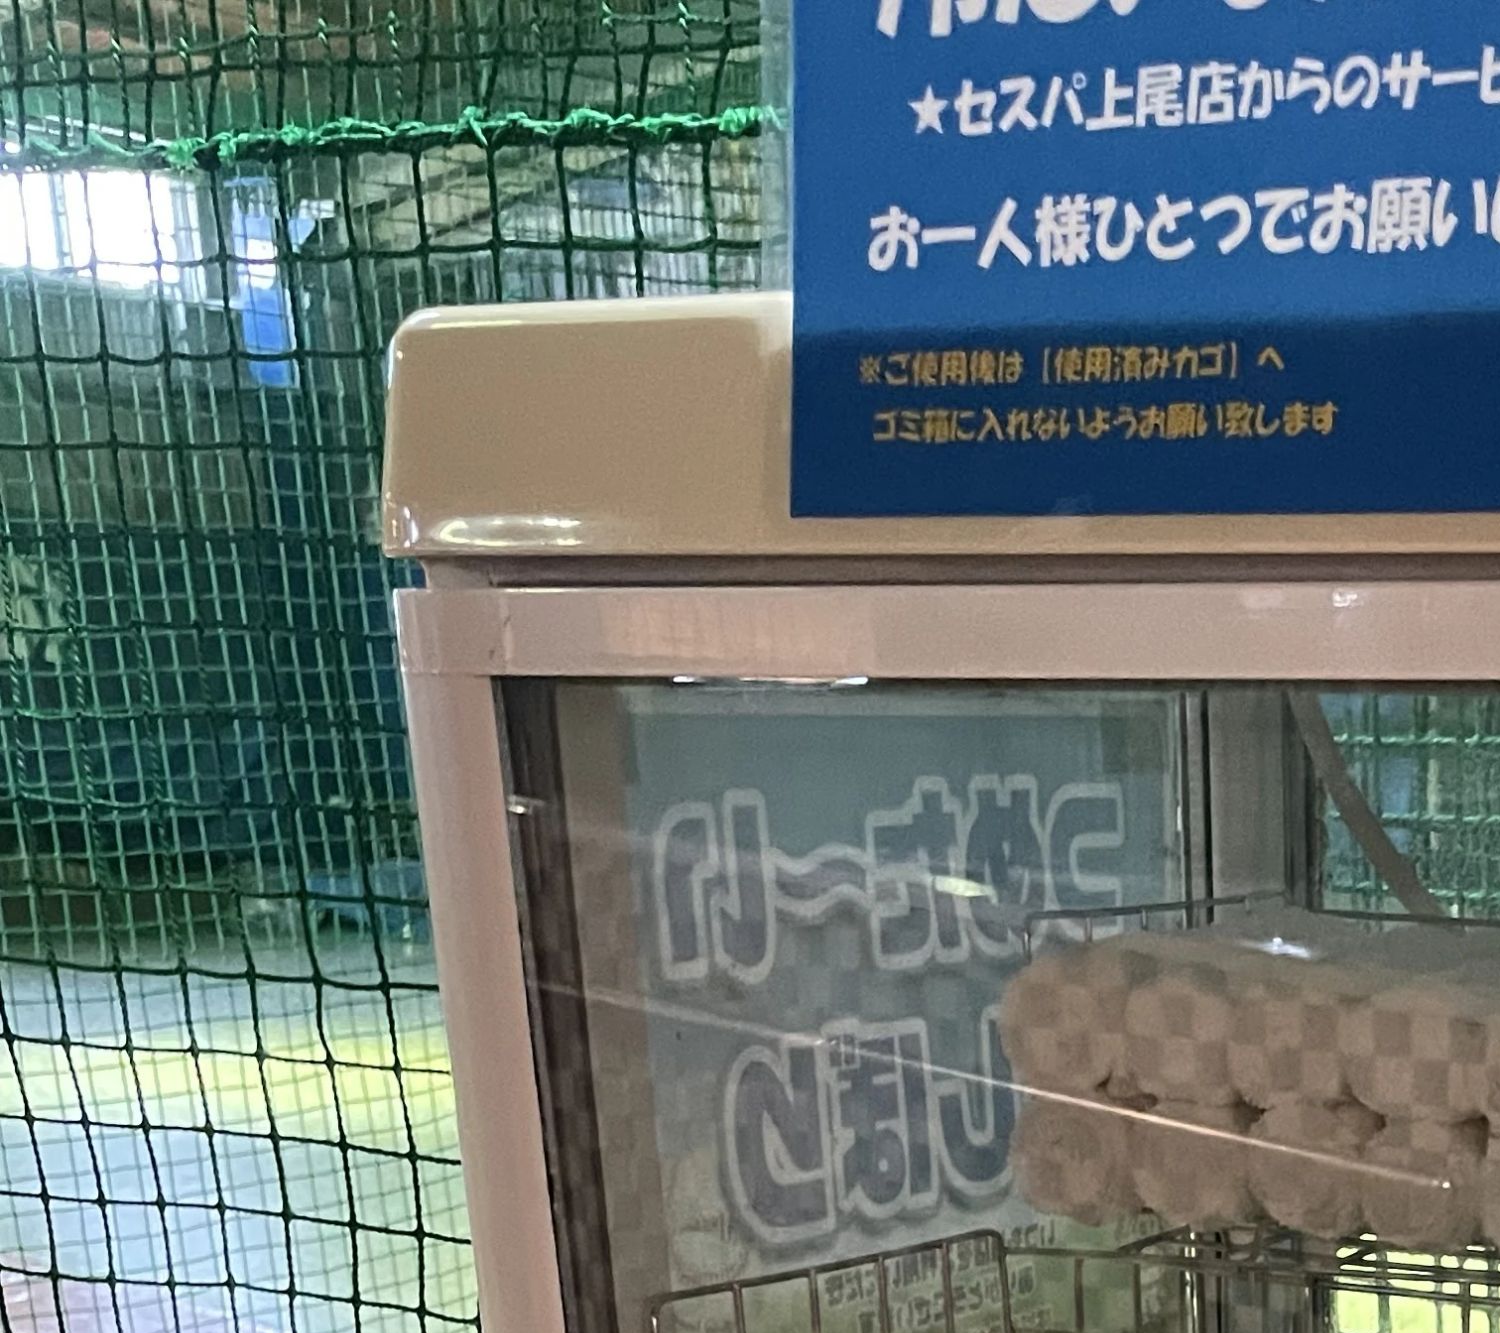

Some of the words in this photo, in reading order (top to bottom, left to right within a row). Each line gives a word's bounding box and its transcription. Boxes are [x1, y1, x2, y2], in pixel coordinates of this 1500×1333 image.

[872, 401, 1337, 443] ゴミ箱に入れないようお願い致します
